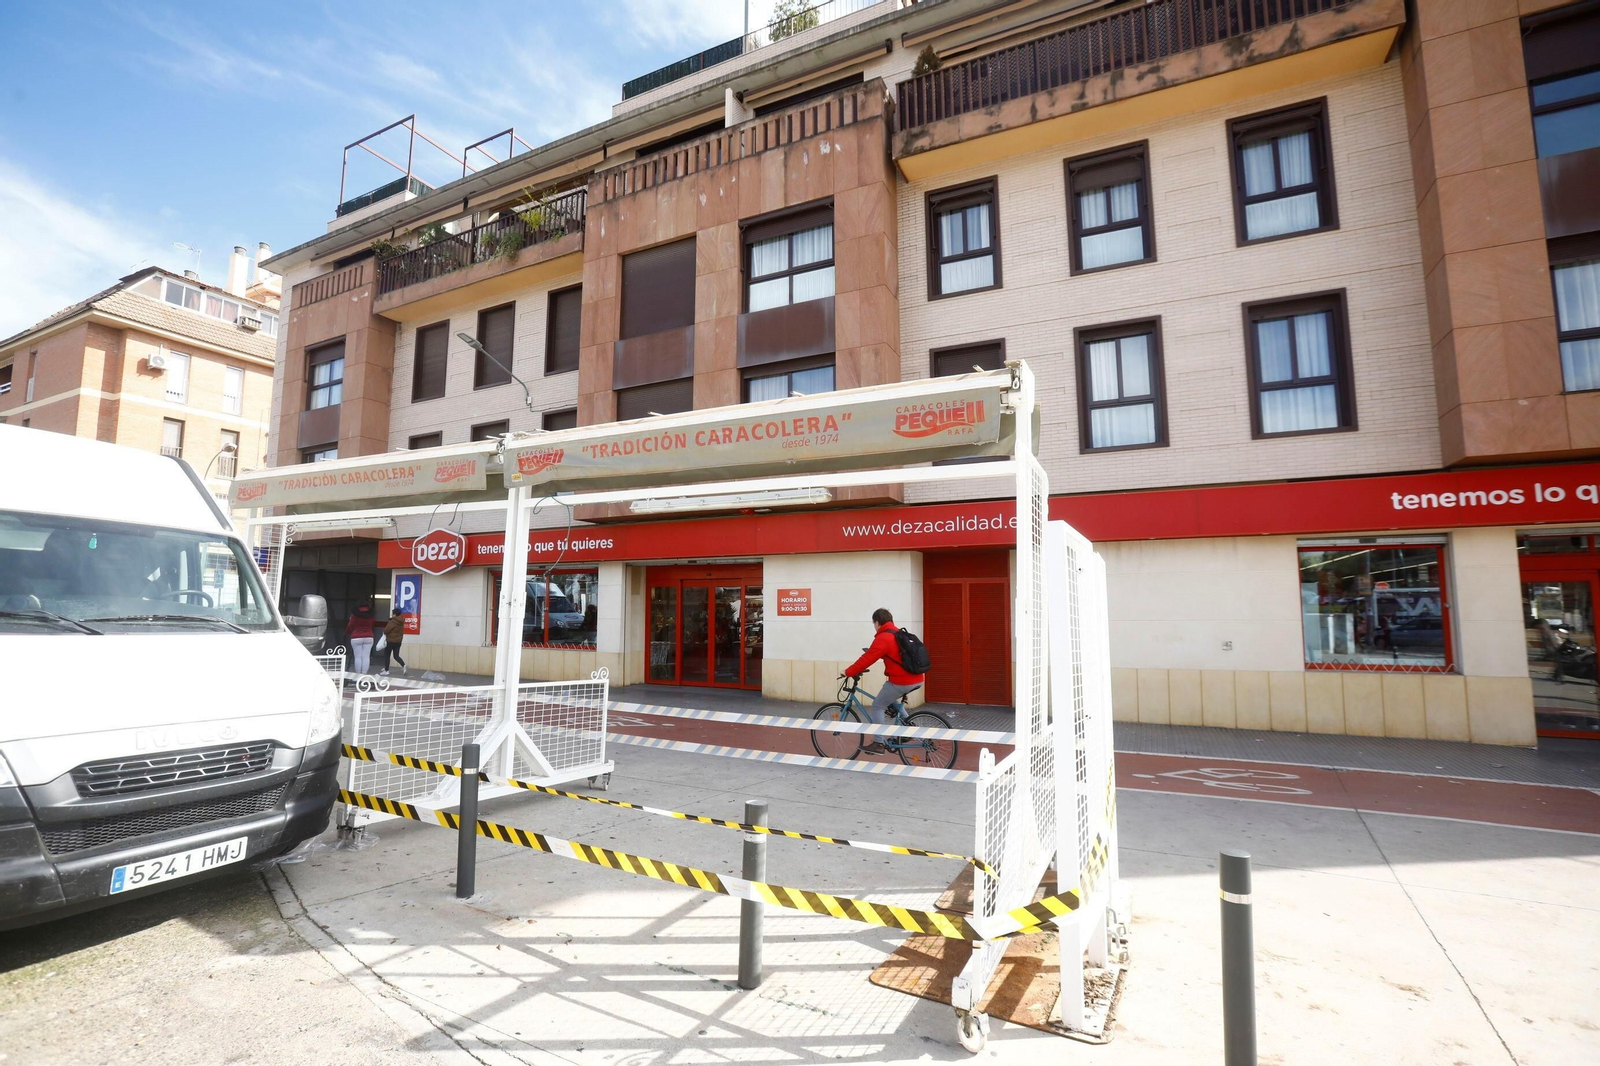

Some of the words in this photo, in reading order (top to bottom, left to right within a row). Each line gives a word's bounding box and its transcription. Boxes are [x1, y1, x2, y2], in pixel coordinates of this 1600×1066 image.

[895, 399, 965, 414] CARACOLES
[582, 431, 687, 459] "TRADICIÓN
[695, 412, 852, 447] CARACOLERA"
[781, 436, 811, 449] desde
[814, 433, 839, 446] 1974
[947, 427, 974, 436] RAFA
[1390, 488, 1525, 510] tenemos
[1534, 482, 1566, 503] lo
[1575, 485, 1600, 504] q
[842, 513, 1018, 537] www.dezacalidad.e
[534, 541, 555, 554] que
[571, 537, 614, 552] quieres
[400, 581, 416, 609] P
[130, 854, 192, 884] 5241
[201, 841, 243, 868] HMJ
